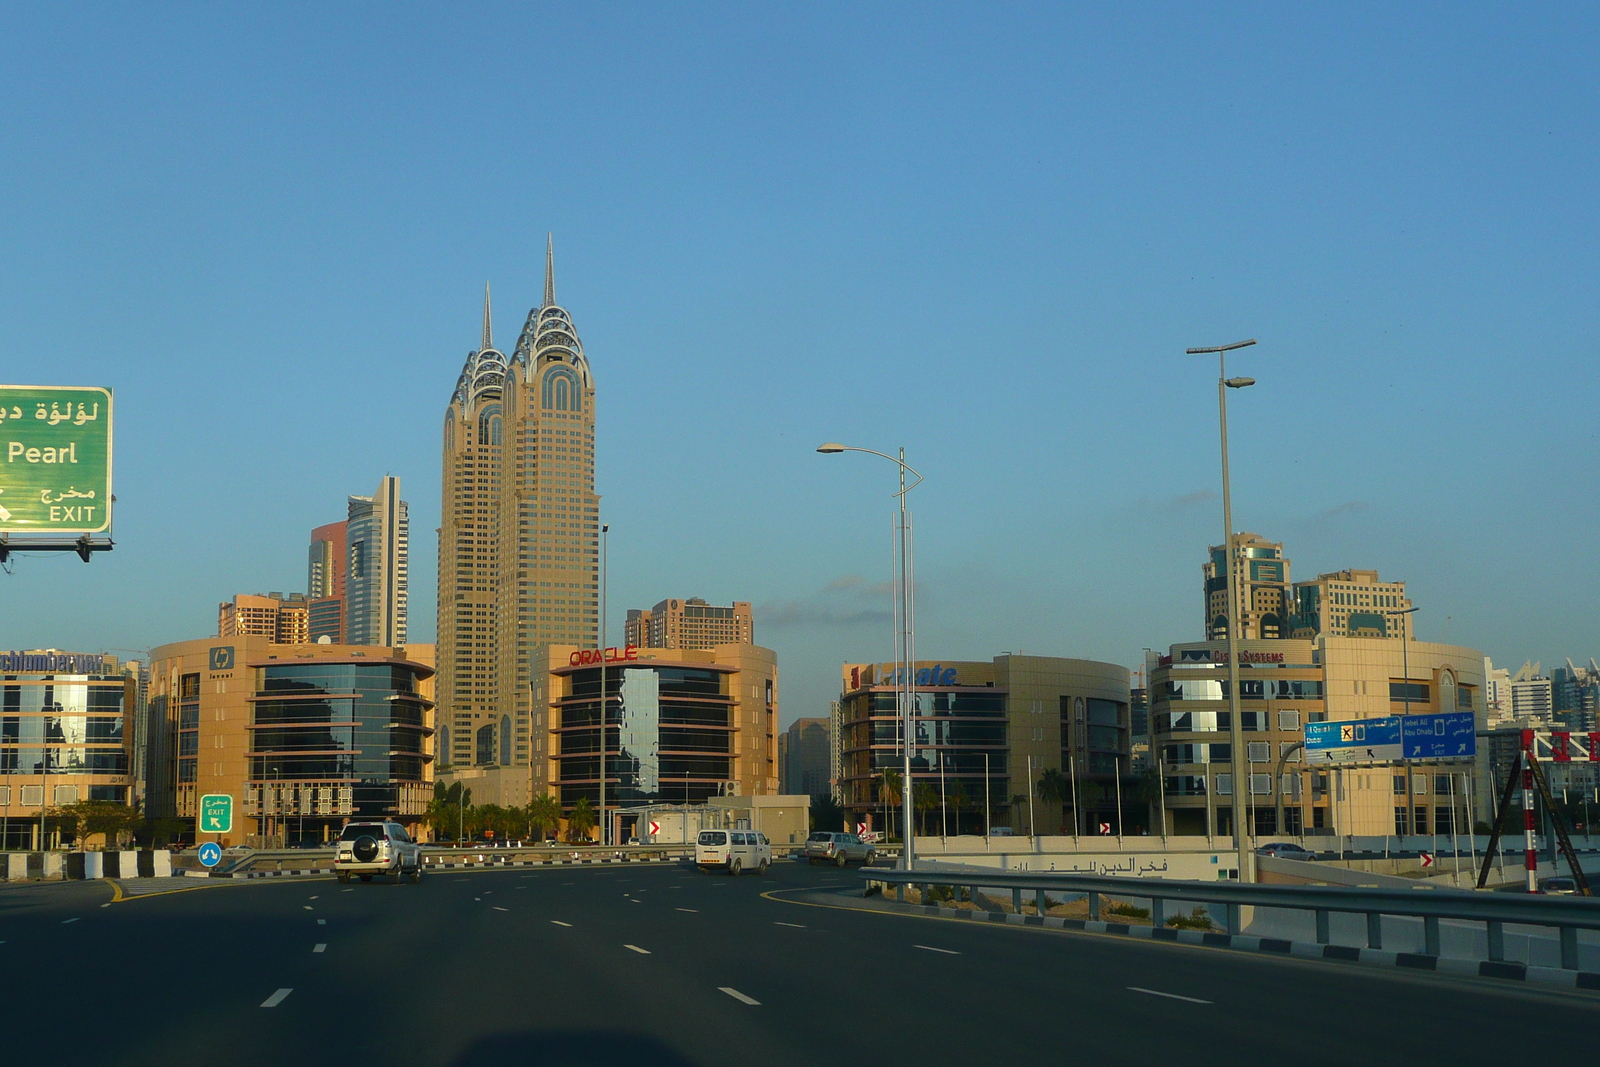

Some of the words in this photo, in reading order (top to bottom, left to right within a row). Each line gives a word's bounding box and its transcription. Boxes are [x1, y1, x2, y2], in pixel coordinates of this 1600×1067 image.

[35, 402, 99, 425] لؤلؤة
[8, 442, 78, 464] Pearl
[40, 486, 96, 504] مخرج
[49, 506, 96, 522] EXIT
[0, 650, 103, 674] chlumberger
[569, 644, 638, 666] ORACLE
[1214, 650, 1241, 662] CIS
[1404, 718, 1419, 727] Jebel
[1419, 717, 1428, 726] Ali
[1416, 728, 1433, 736] Dhabi
[205, 799, 228, 807] مخرج
[1100, 857, 1135, 876] الدين
[1138, 858, 1168, 876] فخر
